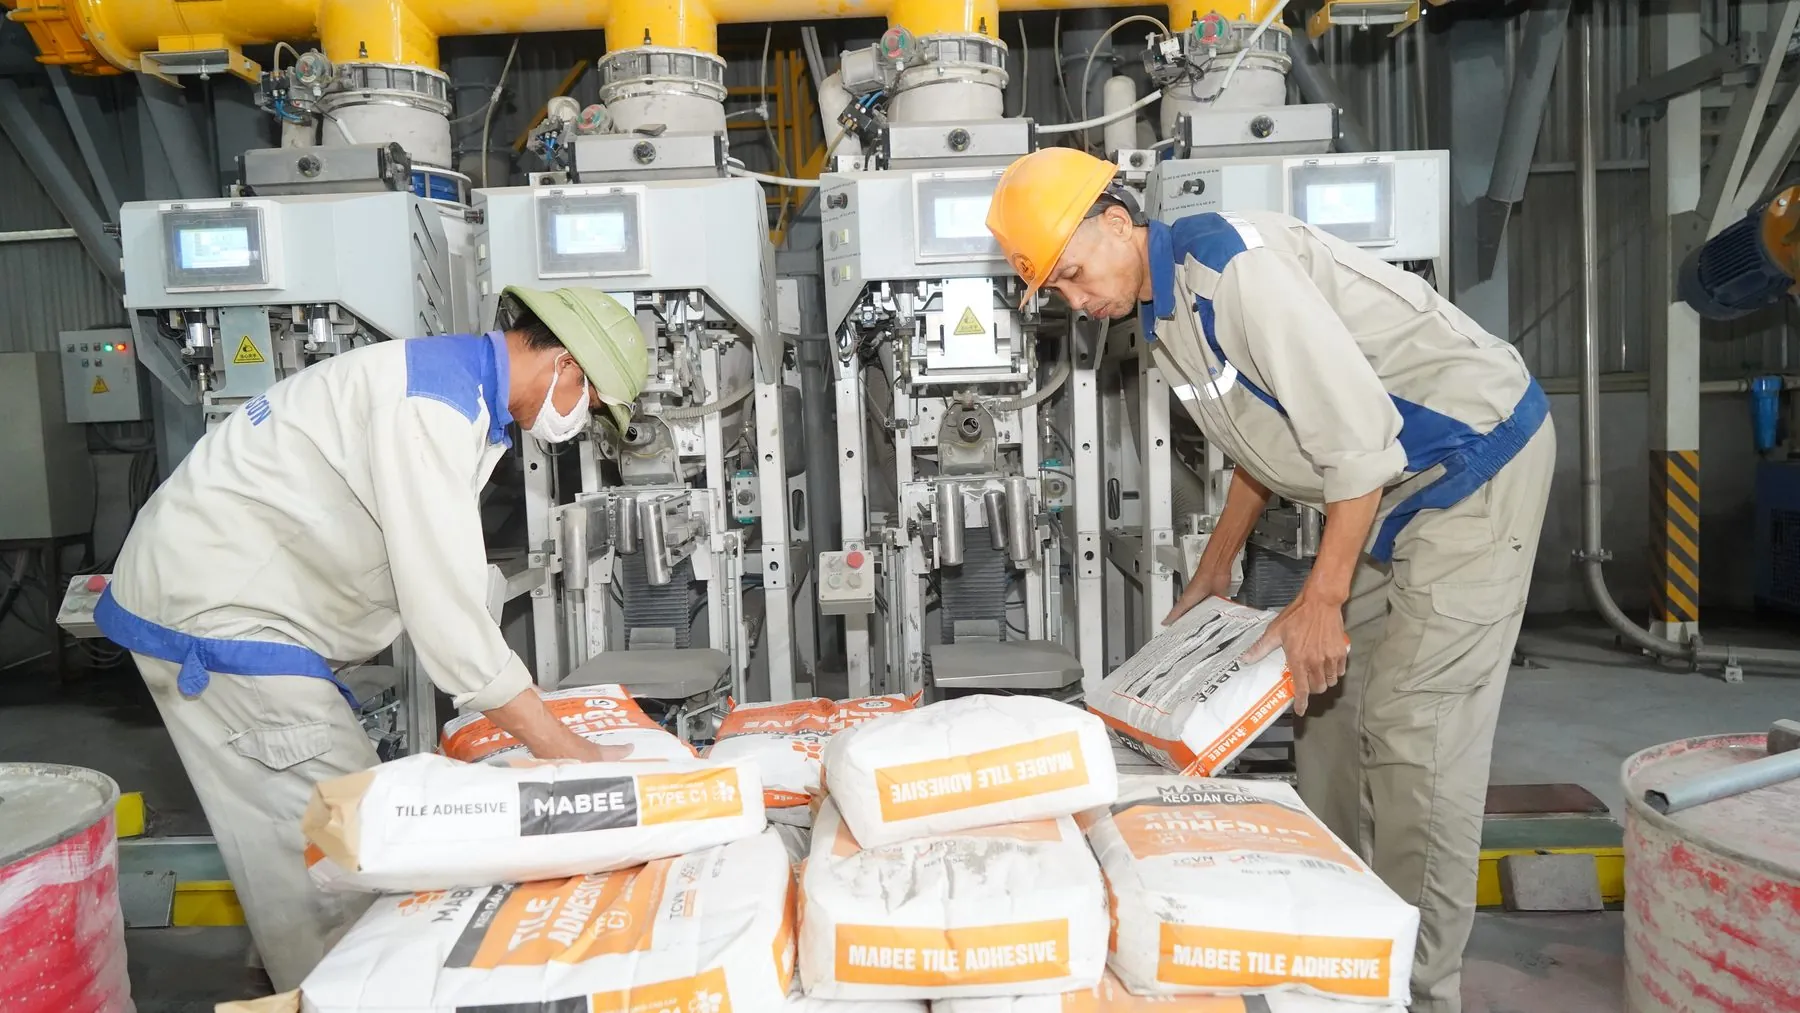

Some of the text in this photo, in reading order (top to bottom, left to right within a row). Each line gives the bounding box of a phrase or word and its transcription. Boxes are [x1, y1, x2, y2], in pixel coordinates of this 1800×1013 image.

[1250, 695, 1282, 724] MABEE
[568, 717, 639, 733] TILE
[1208, 734, 1238, 762] MABEE
[891, 751, 1075, 803] MABEE TILE ADHESIVE
[395, 801, 508, 817] TILE ADHESIVE
[534, 791, 625, 816] MABEE
[646, 790, 686, 807] TYPE
[1143, 820, 1316, 838] ADHESI
[508, 896, 560, 951] TILE
[848, 940, 1058, 972] MABEE TILE ADHESIVE
[1173, 944, 1380, 980] MABEE TILE ADHESIVE
